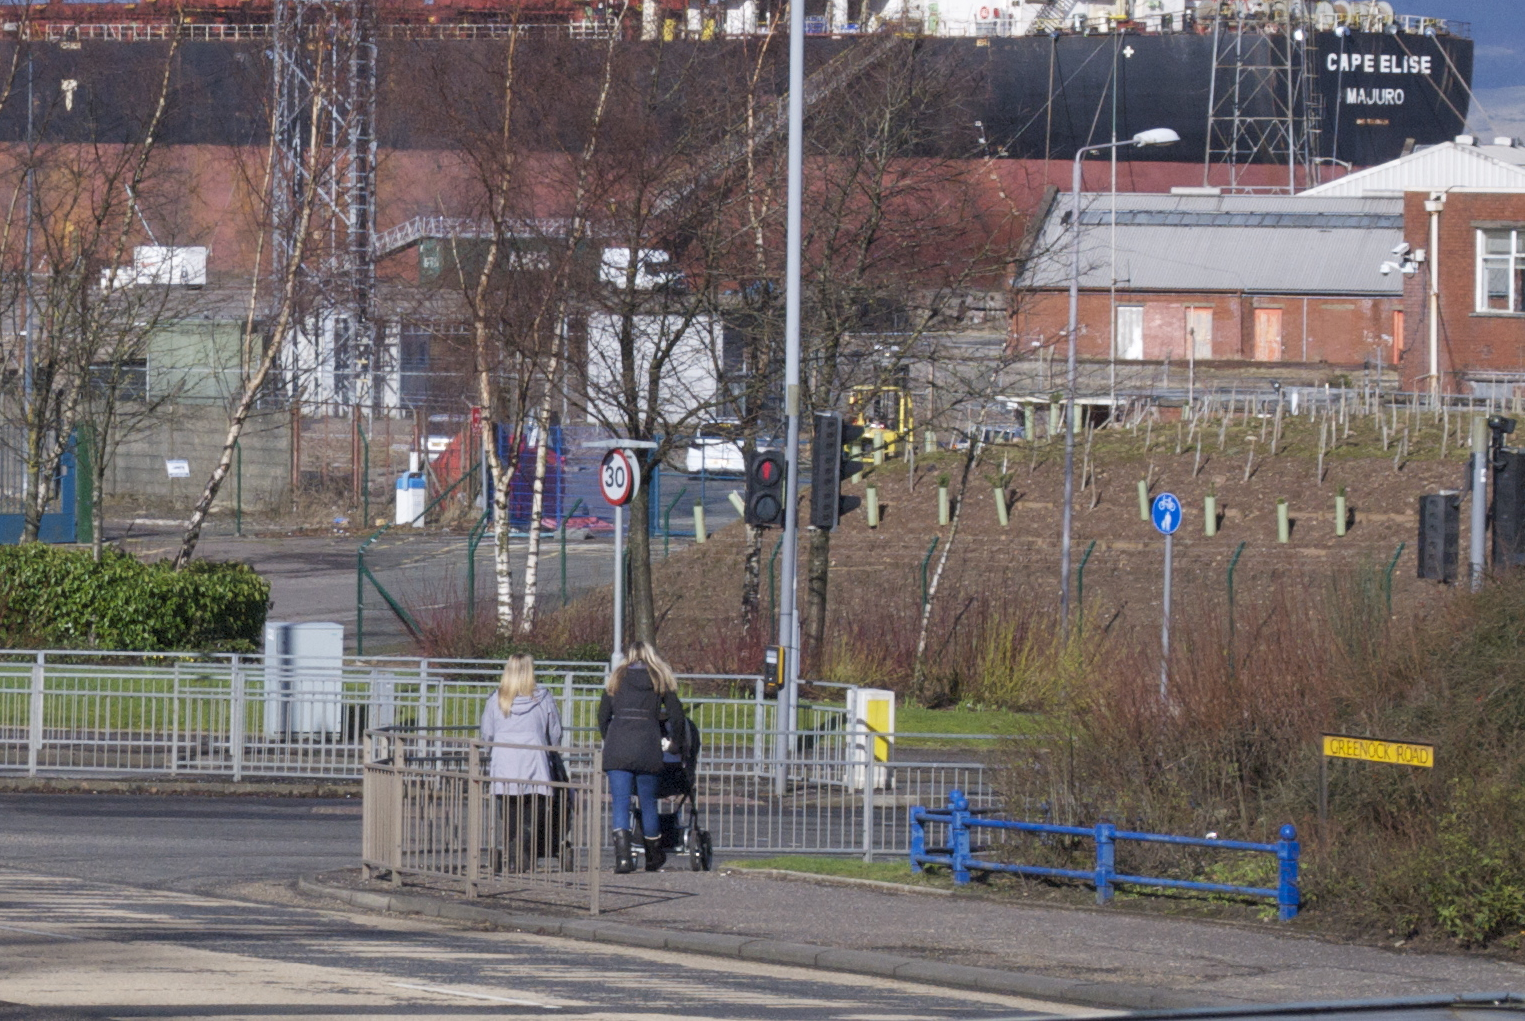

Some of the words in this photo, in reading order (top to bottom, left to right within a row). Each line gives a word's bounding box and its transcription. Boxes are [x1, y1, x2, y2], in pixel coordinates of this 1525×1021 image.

[1327, 53, 1375, 73] CAPE
[1380, 54, 1432, 75] ELISE
[1346, 87, 1405, 106] MAJURO
[605, 466, 625, 488] 30
[1329, 738, 1391, 761] GREENOCK
[1396, 746, 1429, 764] ROAD
